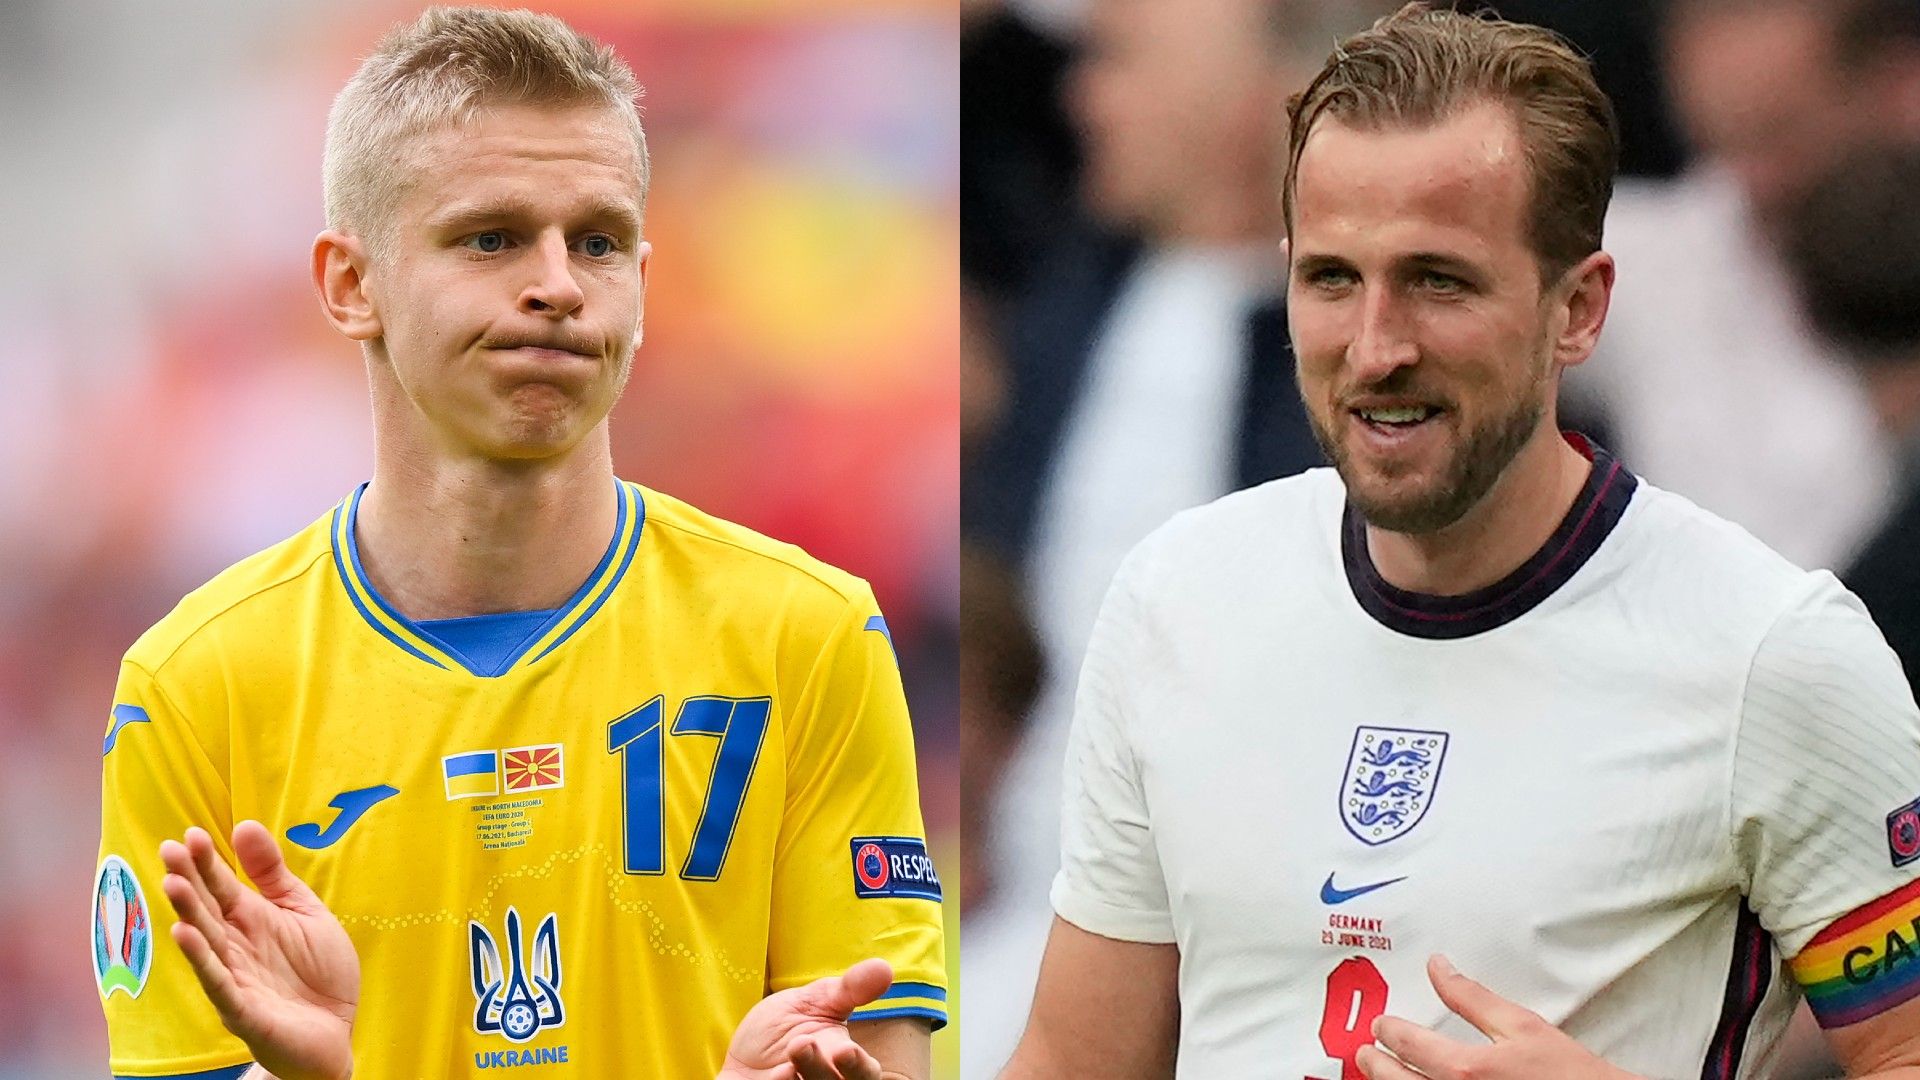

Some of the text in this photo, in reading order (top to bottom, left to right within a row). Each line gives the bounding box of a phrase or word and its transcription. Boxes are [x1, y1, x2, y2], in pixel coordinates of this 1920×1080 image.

[606, 693, 772, 883] 17
[492, 803, 511, 811] NORTH
[511, 799, 542, 809] MACEDONIA
[495, 812, 510, 820] EURO
[510, 811, 524, 819] 2020
[511, 820, 527, 829] Group
[483, 842, 499, 850] Arena
[860, 846, 880, 857] UEFA
[1329, 913, 1382, 933] GERMANY
[1337, 933, 1365, 948] JUNE
[1368, 935, 1392, 951] 2021
[1304, 955, 1389, 1080] 9
[474, 1046, 569, 1069] UKRAINE
